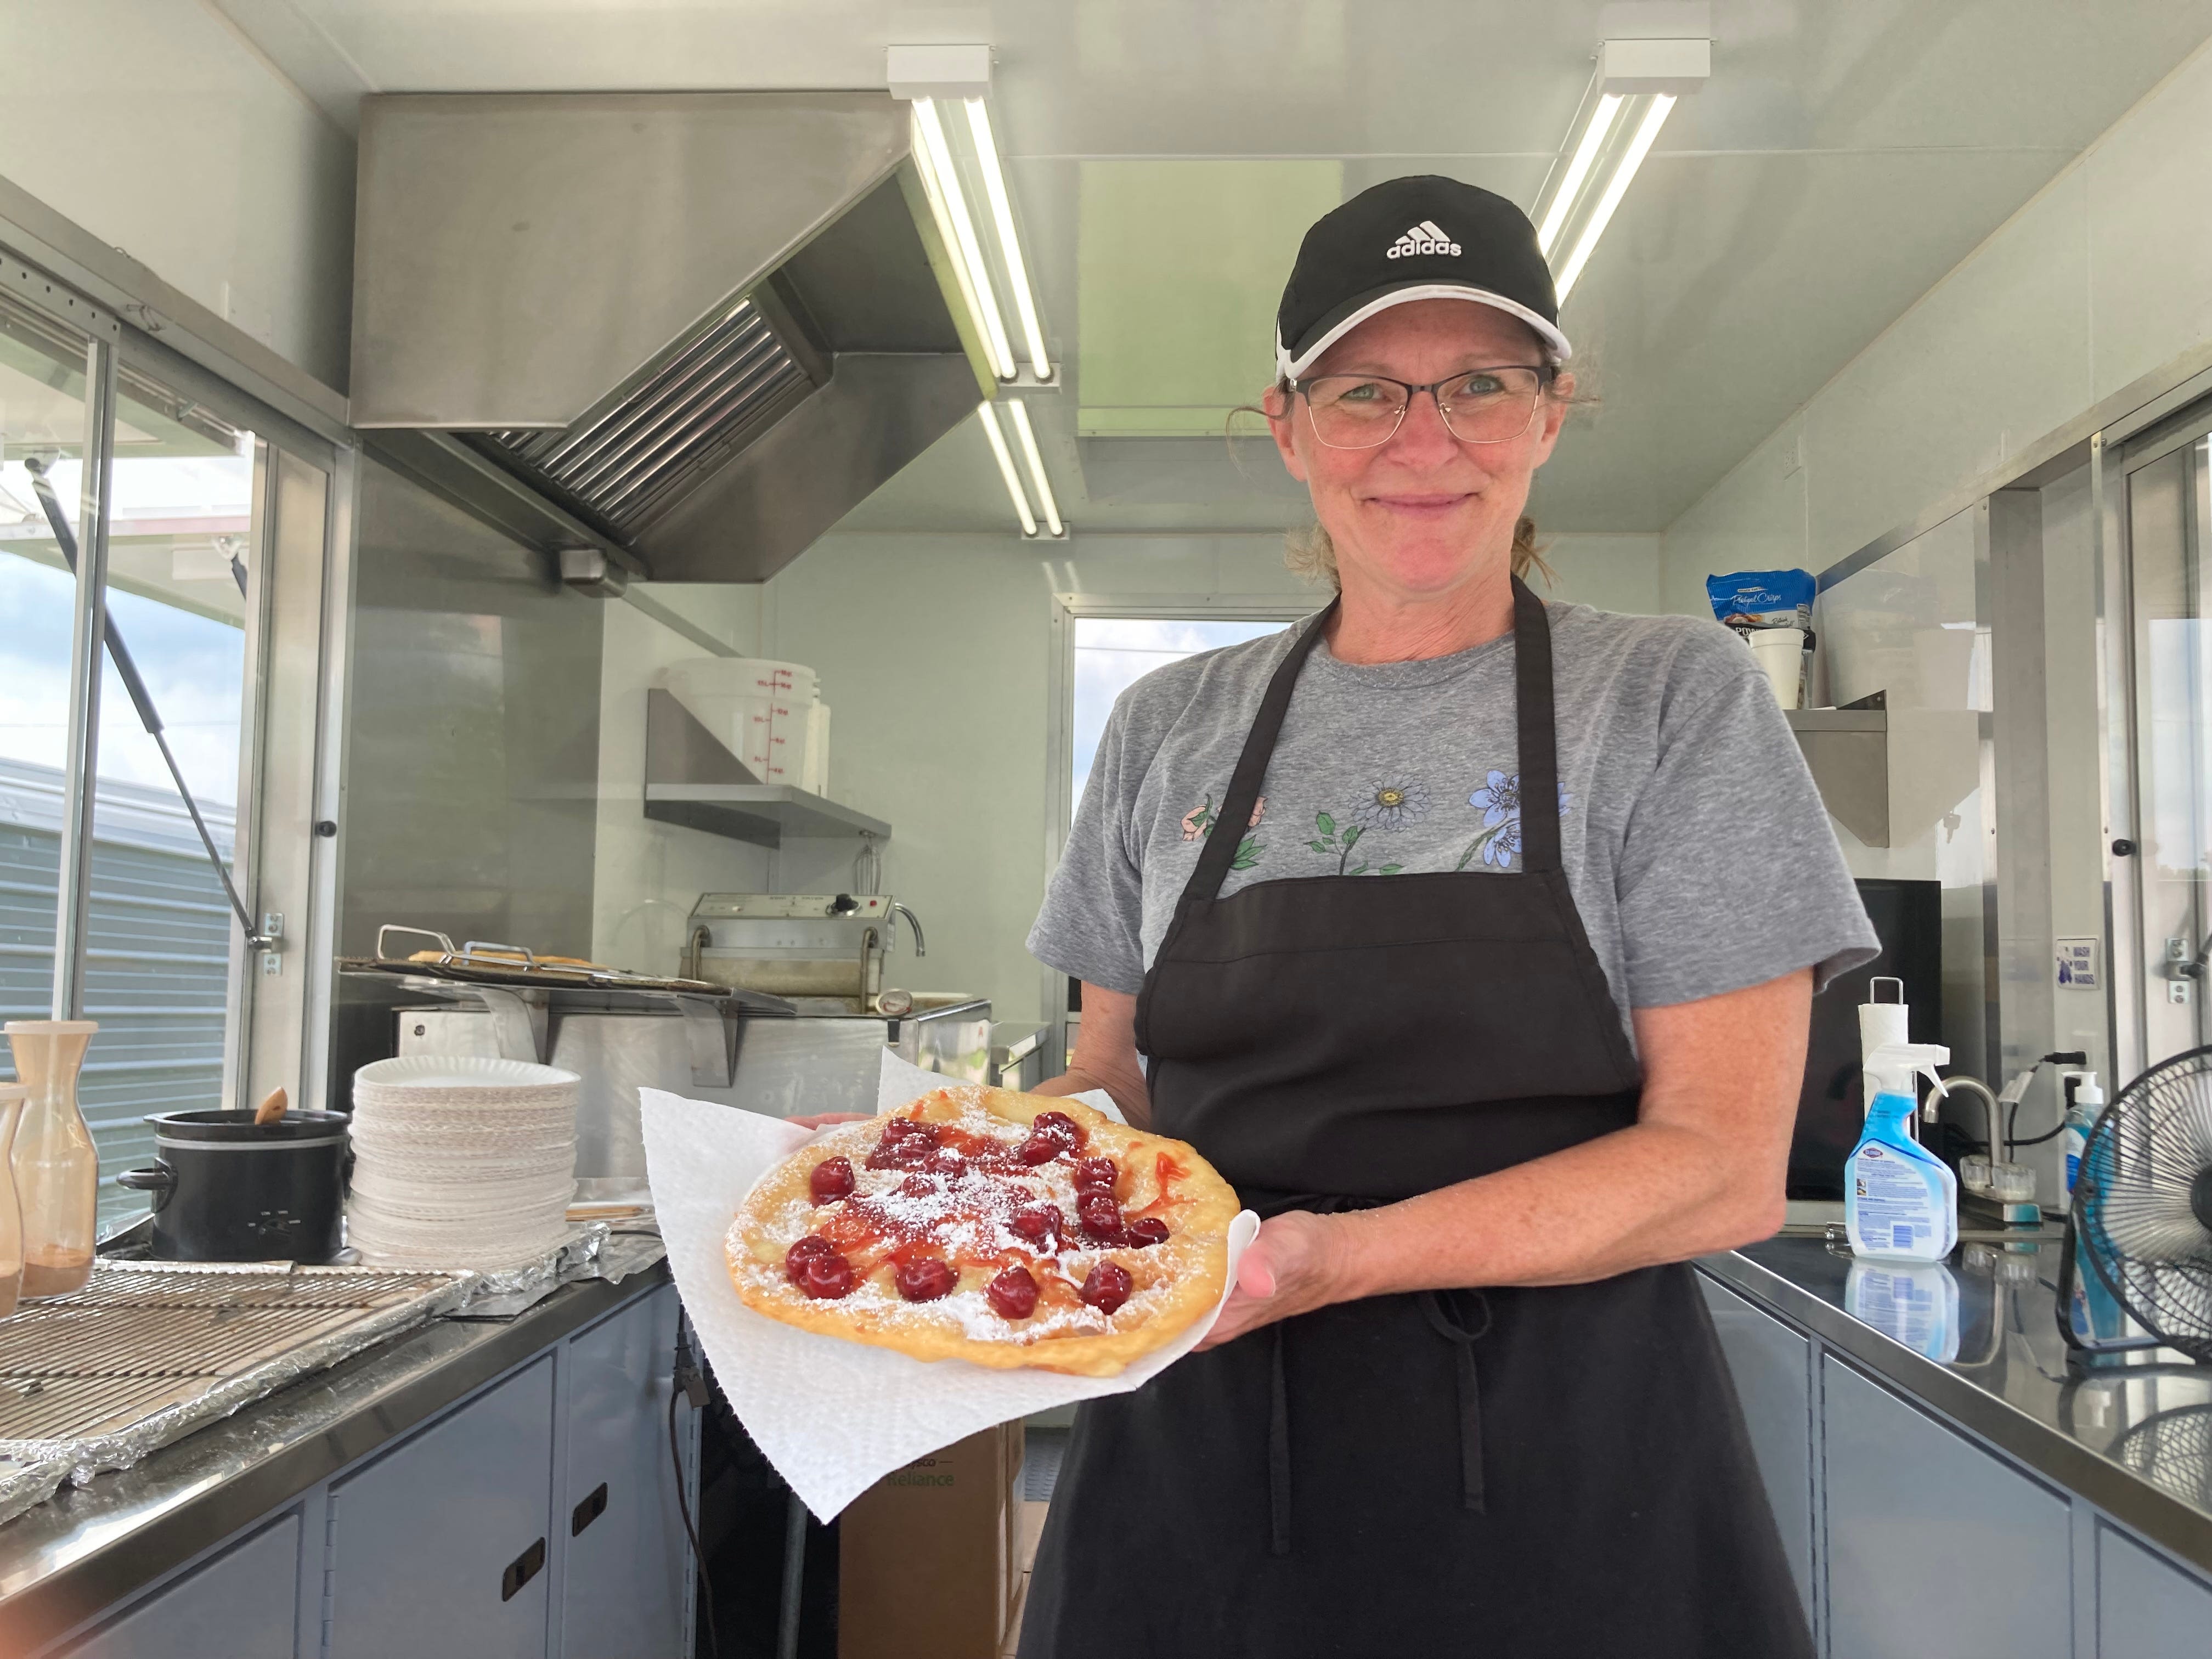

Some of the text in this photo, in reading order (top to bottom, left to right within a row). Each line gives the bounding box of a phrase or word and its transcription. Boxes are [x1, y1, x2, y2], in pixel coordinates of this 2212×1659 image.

[1386, 239, 1462, 259] adidas
[1757, 592, 1781, 603] Crisps
[887, 1471, 954, 1486] Reliance
